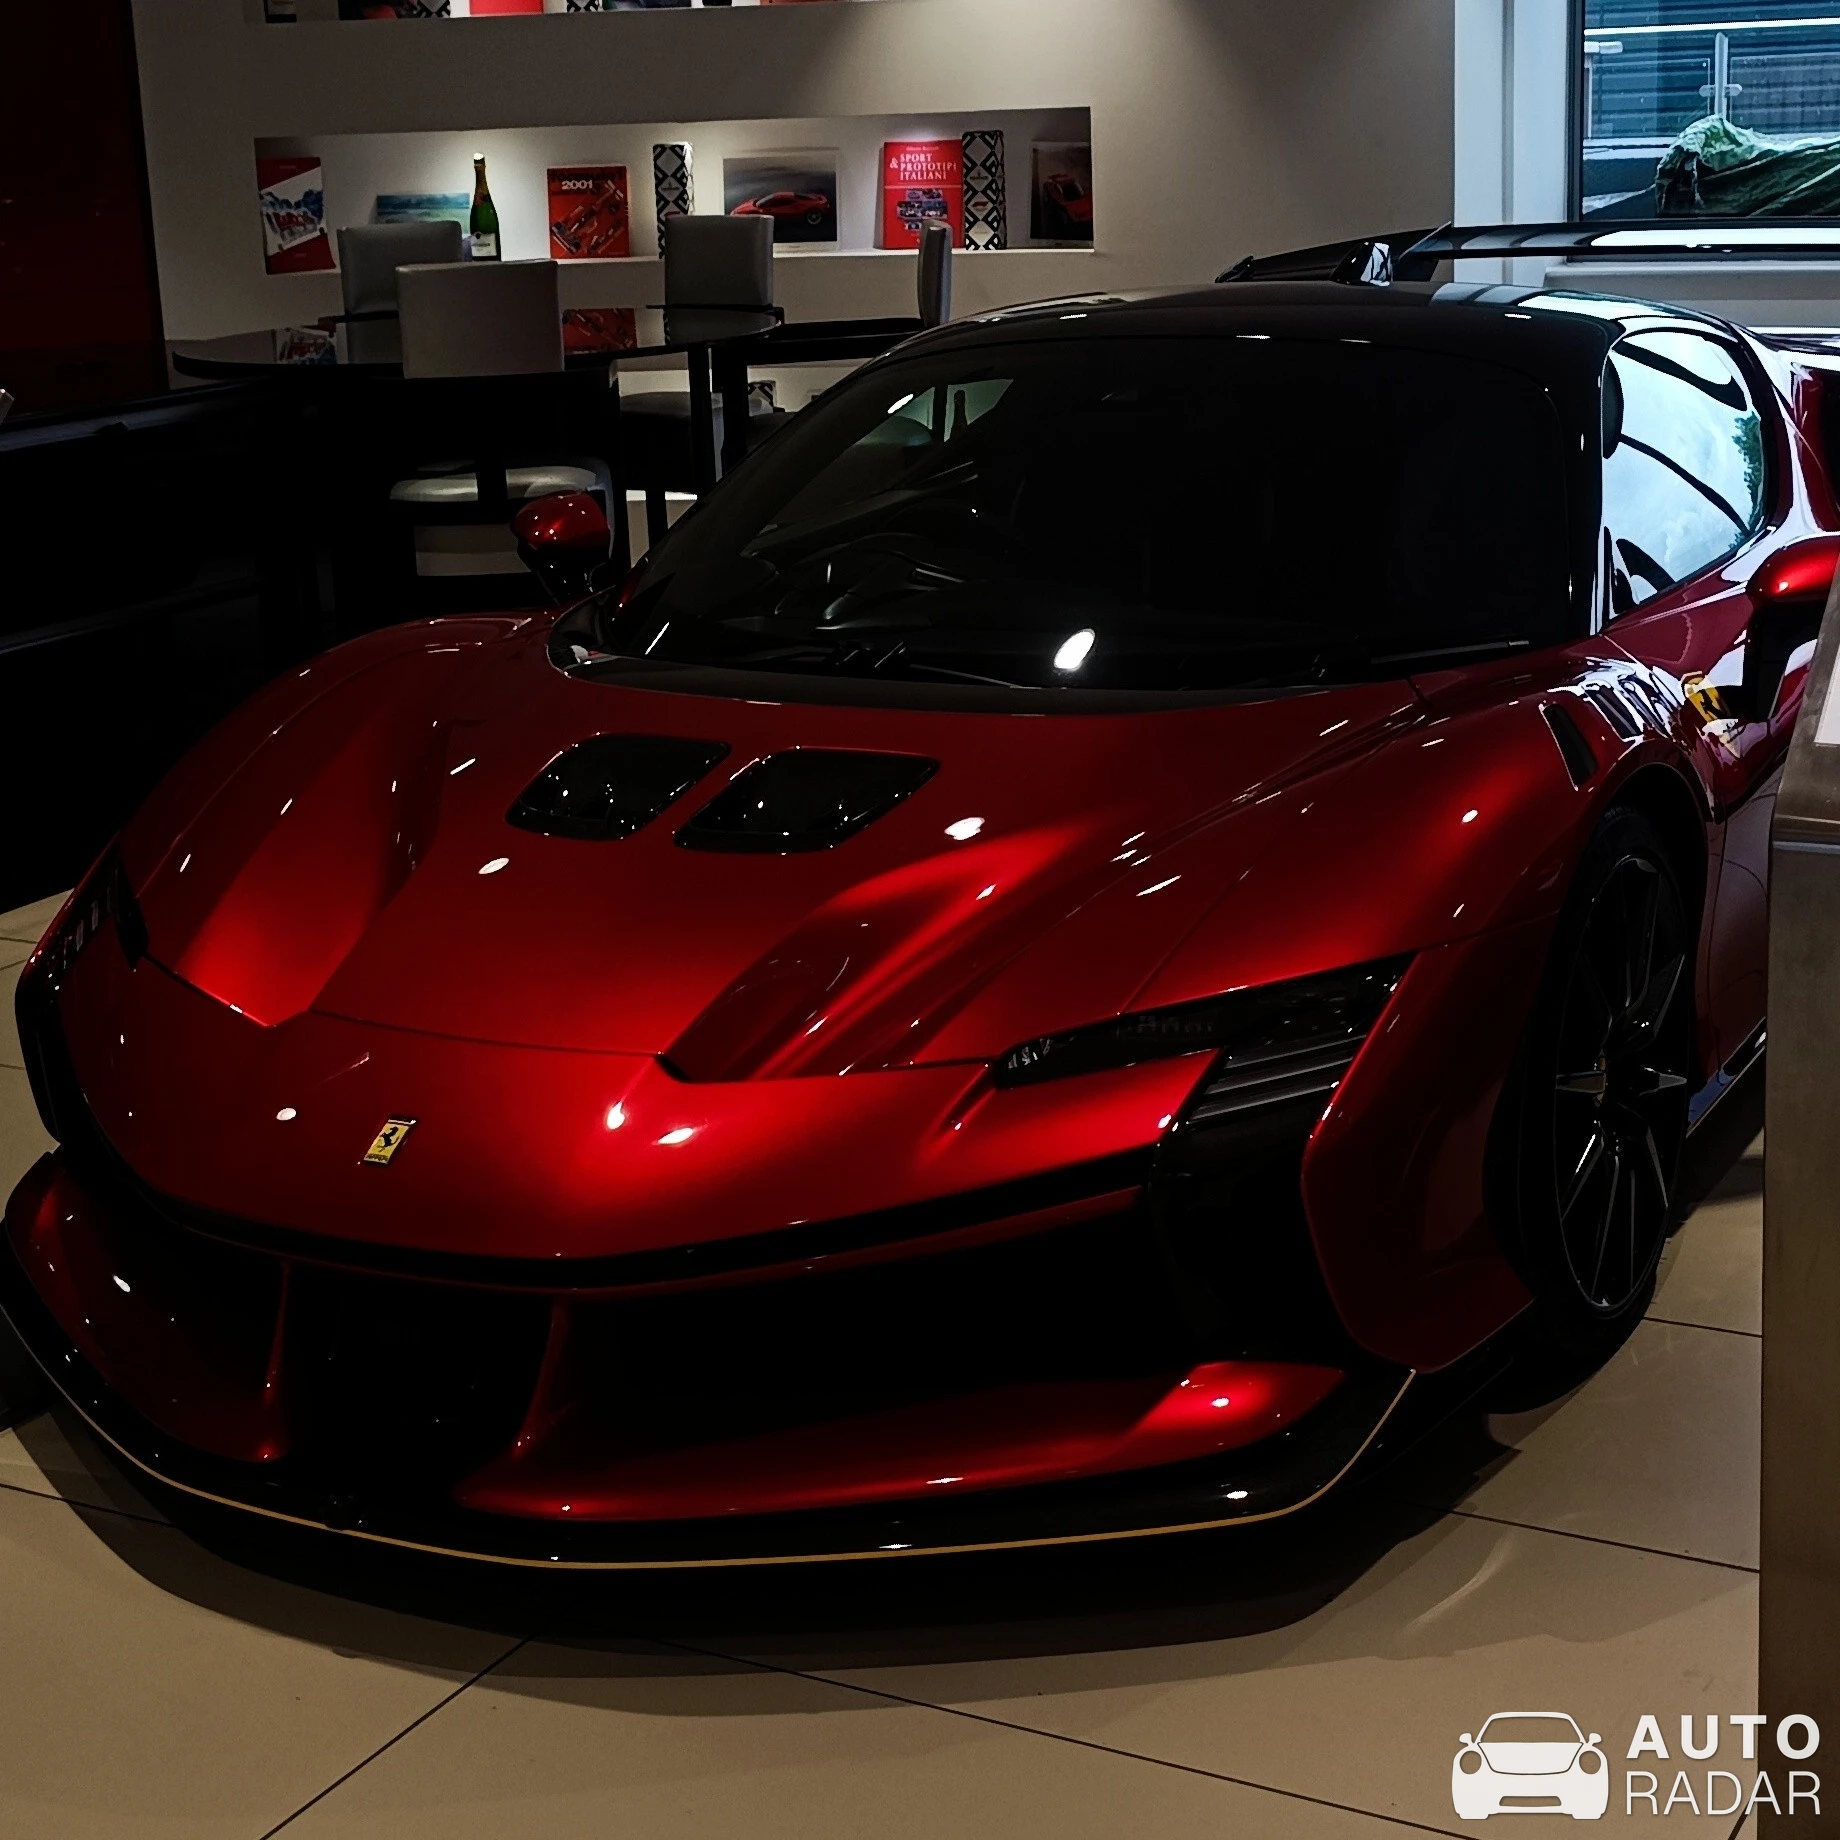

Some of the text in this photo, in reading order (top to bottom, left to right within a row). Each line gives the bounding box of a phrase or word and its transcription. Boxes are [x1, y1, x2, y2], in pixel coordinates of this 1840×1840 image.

[900, 153, 933, 162] SPORT
[889, 157, 957, 171] & PROTOTIPI
[900, 171, 947, 181] ITALIANI
[561, 179, 593, 190] 2001
